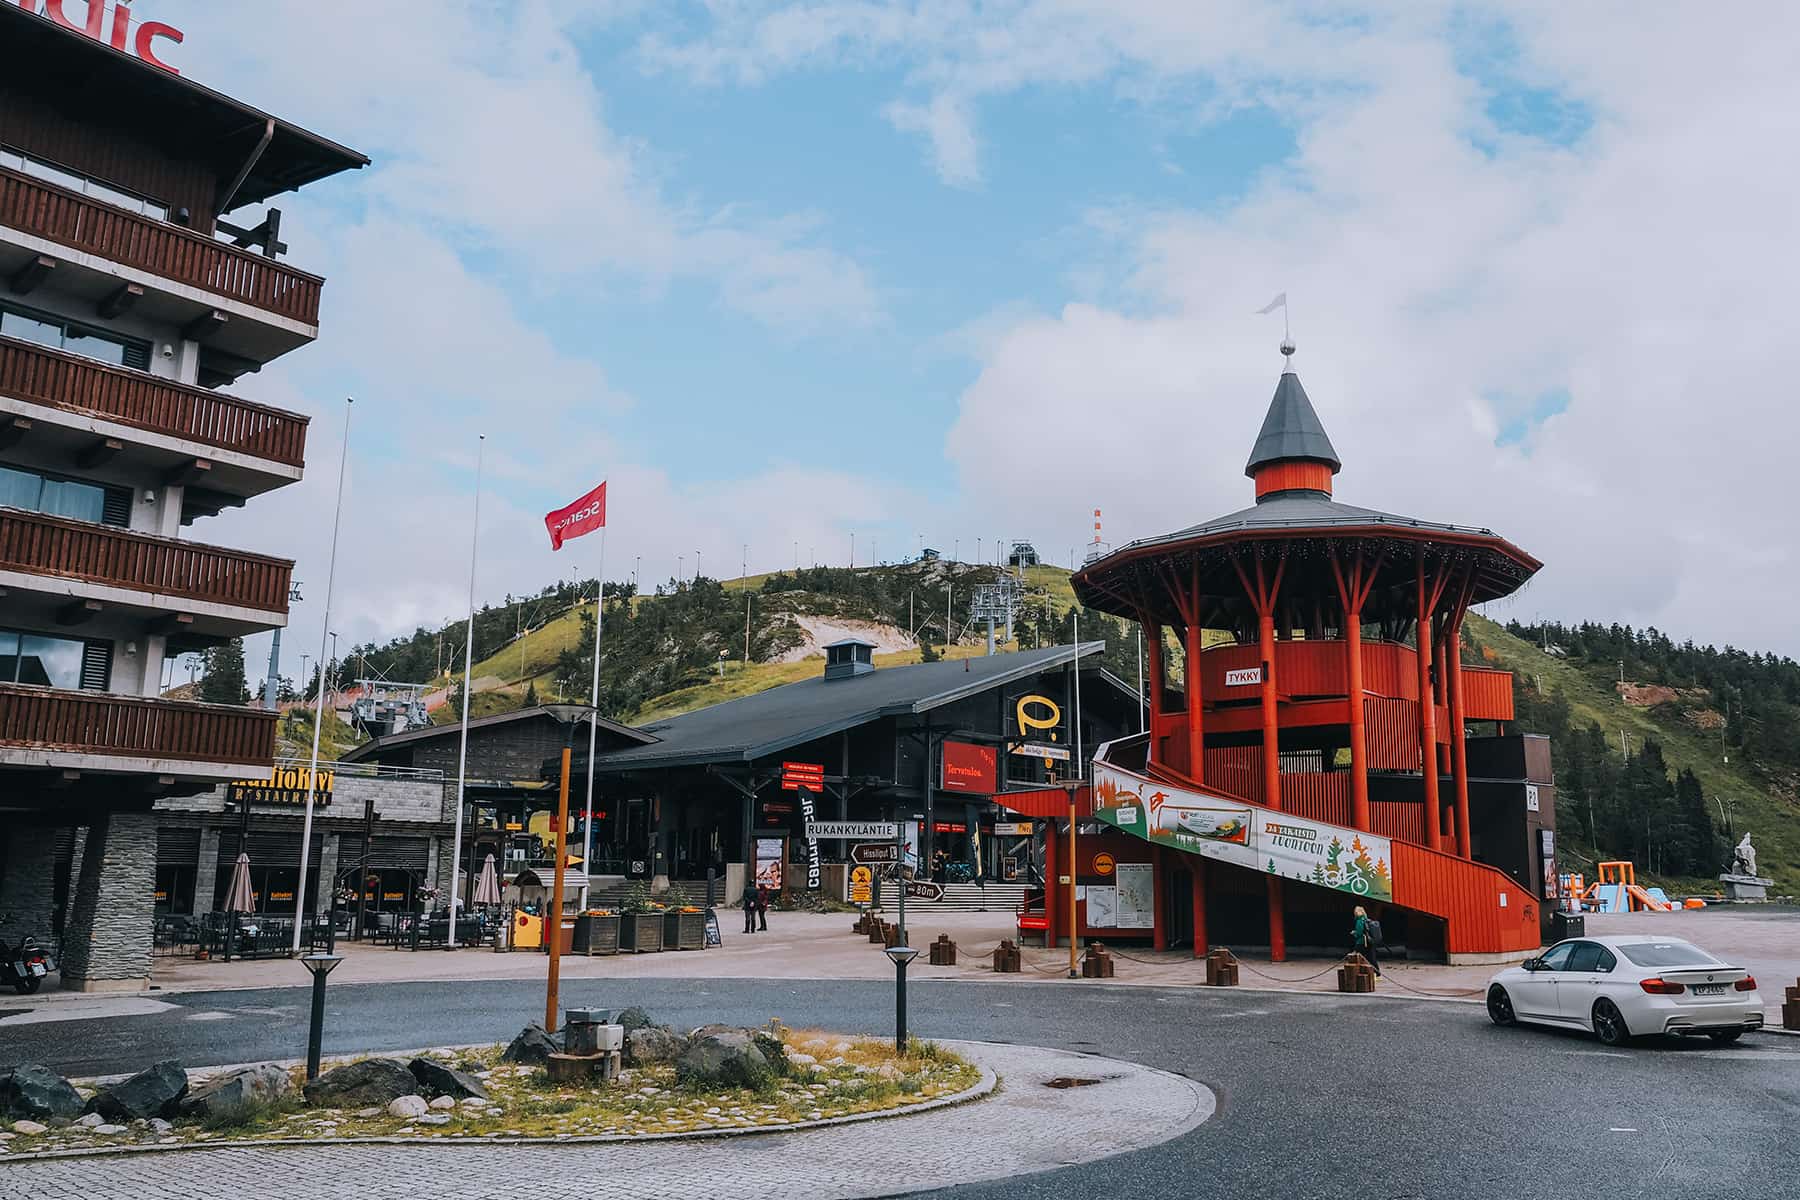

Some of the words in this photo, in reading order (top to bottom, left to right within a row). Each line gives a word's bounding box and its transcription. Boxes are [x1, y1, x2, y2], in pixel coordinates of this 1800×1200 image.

[1228, 671, 1258, 682] TYKKY
[1528, 790, 1537, 806] P2
[808, 823, 893, 835] RUKANKYLÄNTIE
[916, 885, 934, 897] 80m
